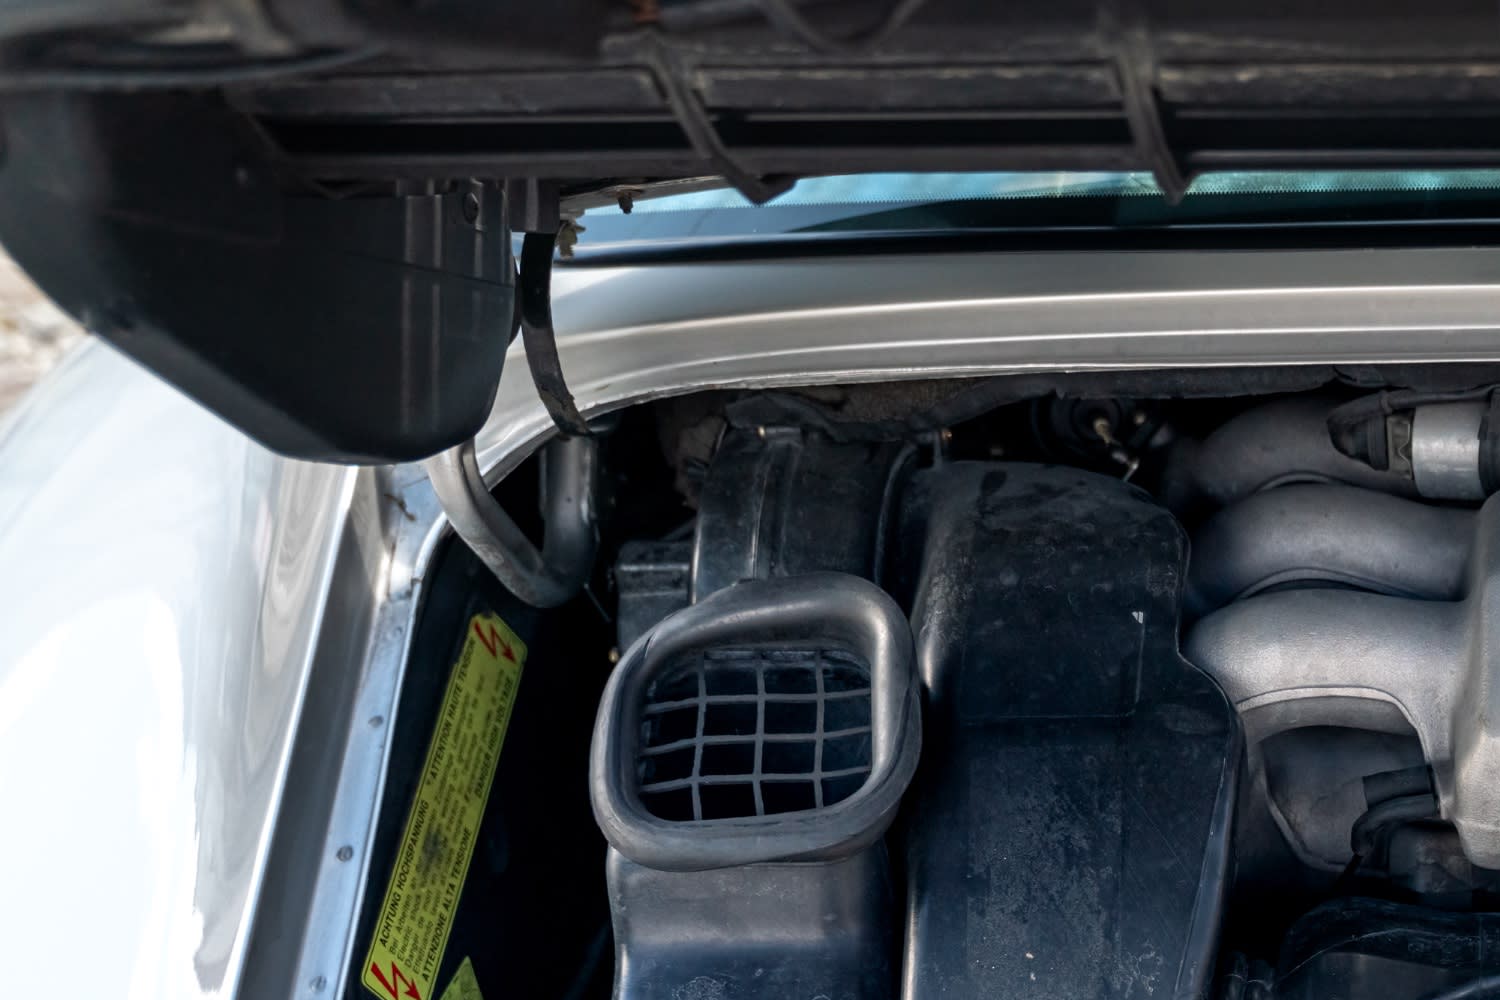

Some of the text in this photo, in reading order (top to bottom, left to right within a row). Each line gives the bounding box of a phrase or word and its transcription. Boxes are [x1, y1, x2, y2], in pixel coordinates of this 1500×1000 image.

[428, 718, 452, 779] ATTENTION
[446, 683, 462, 719] HAUTE
[457, 637, 476, 682] TENSION
[473, 675, 513, 798] DANGER HIGH VOLTAGE
[378, 890, 402, 948] ACHTUNG
[395, 798, 430, 891] HOCHSPANNUNG
[421, 910, 448, 984] ATTENZIONE
[441, 879, 456, 912] ALTA
[450, 824, 472, 882] TENSIONE
[404, 931, 420, 969] Danger
